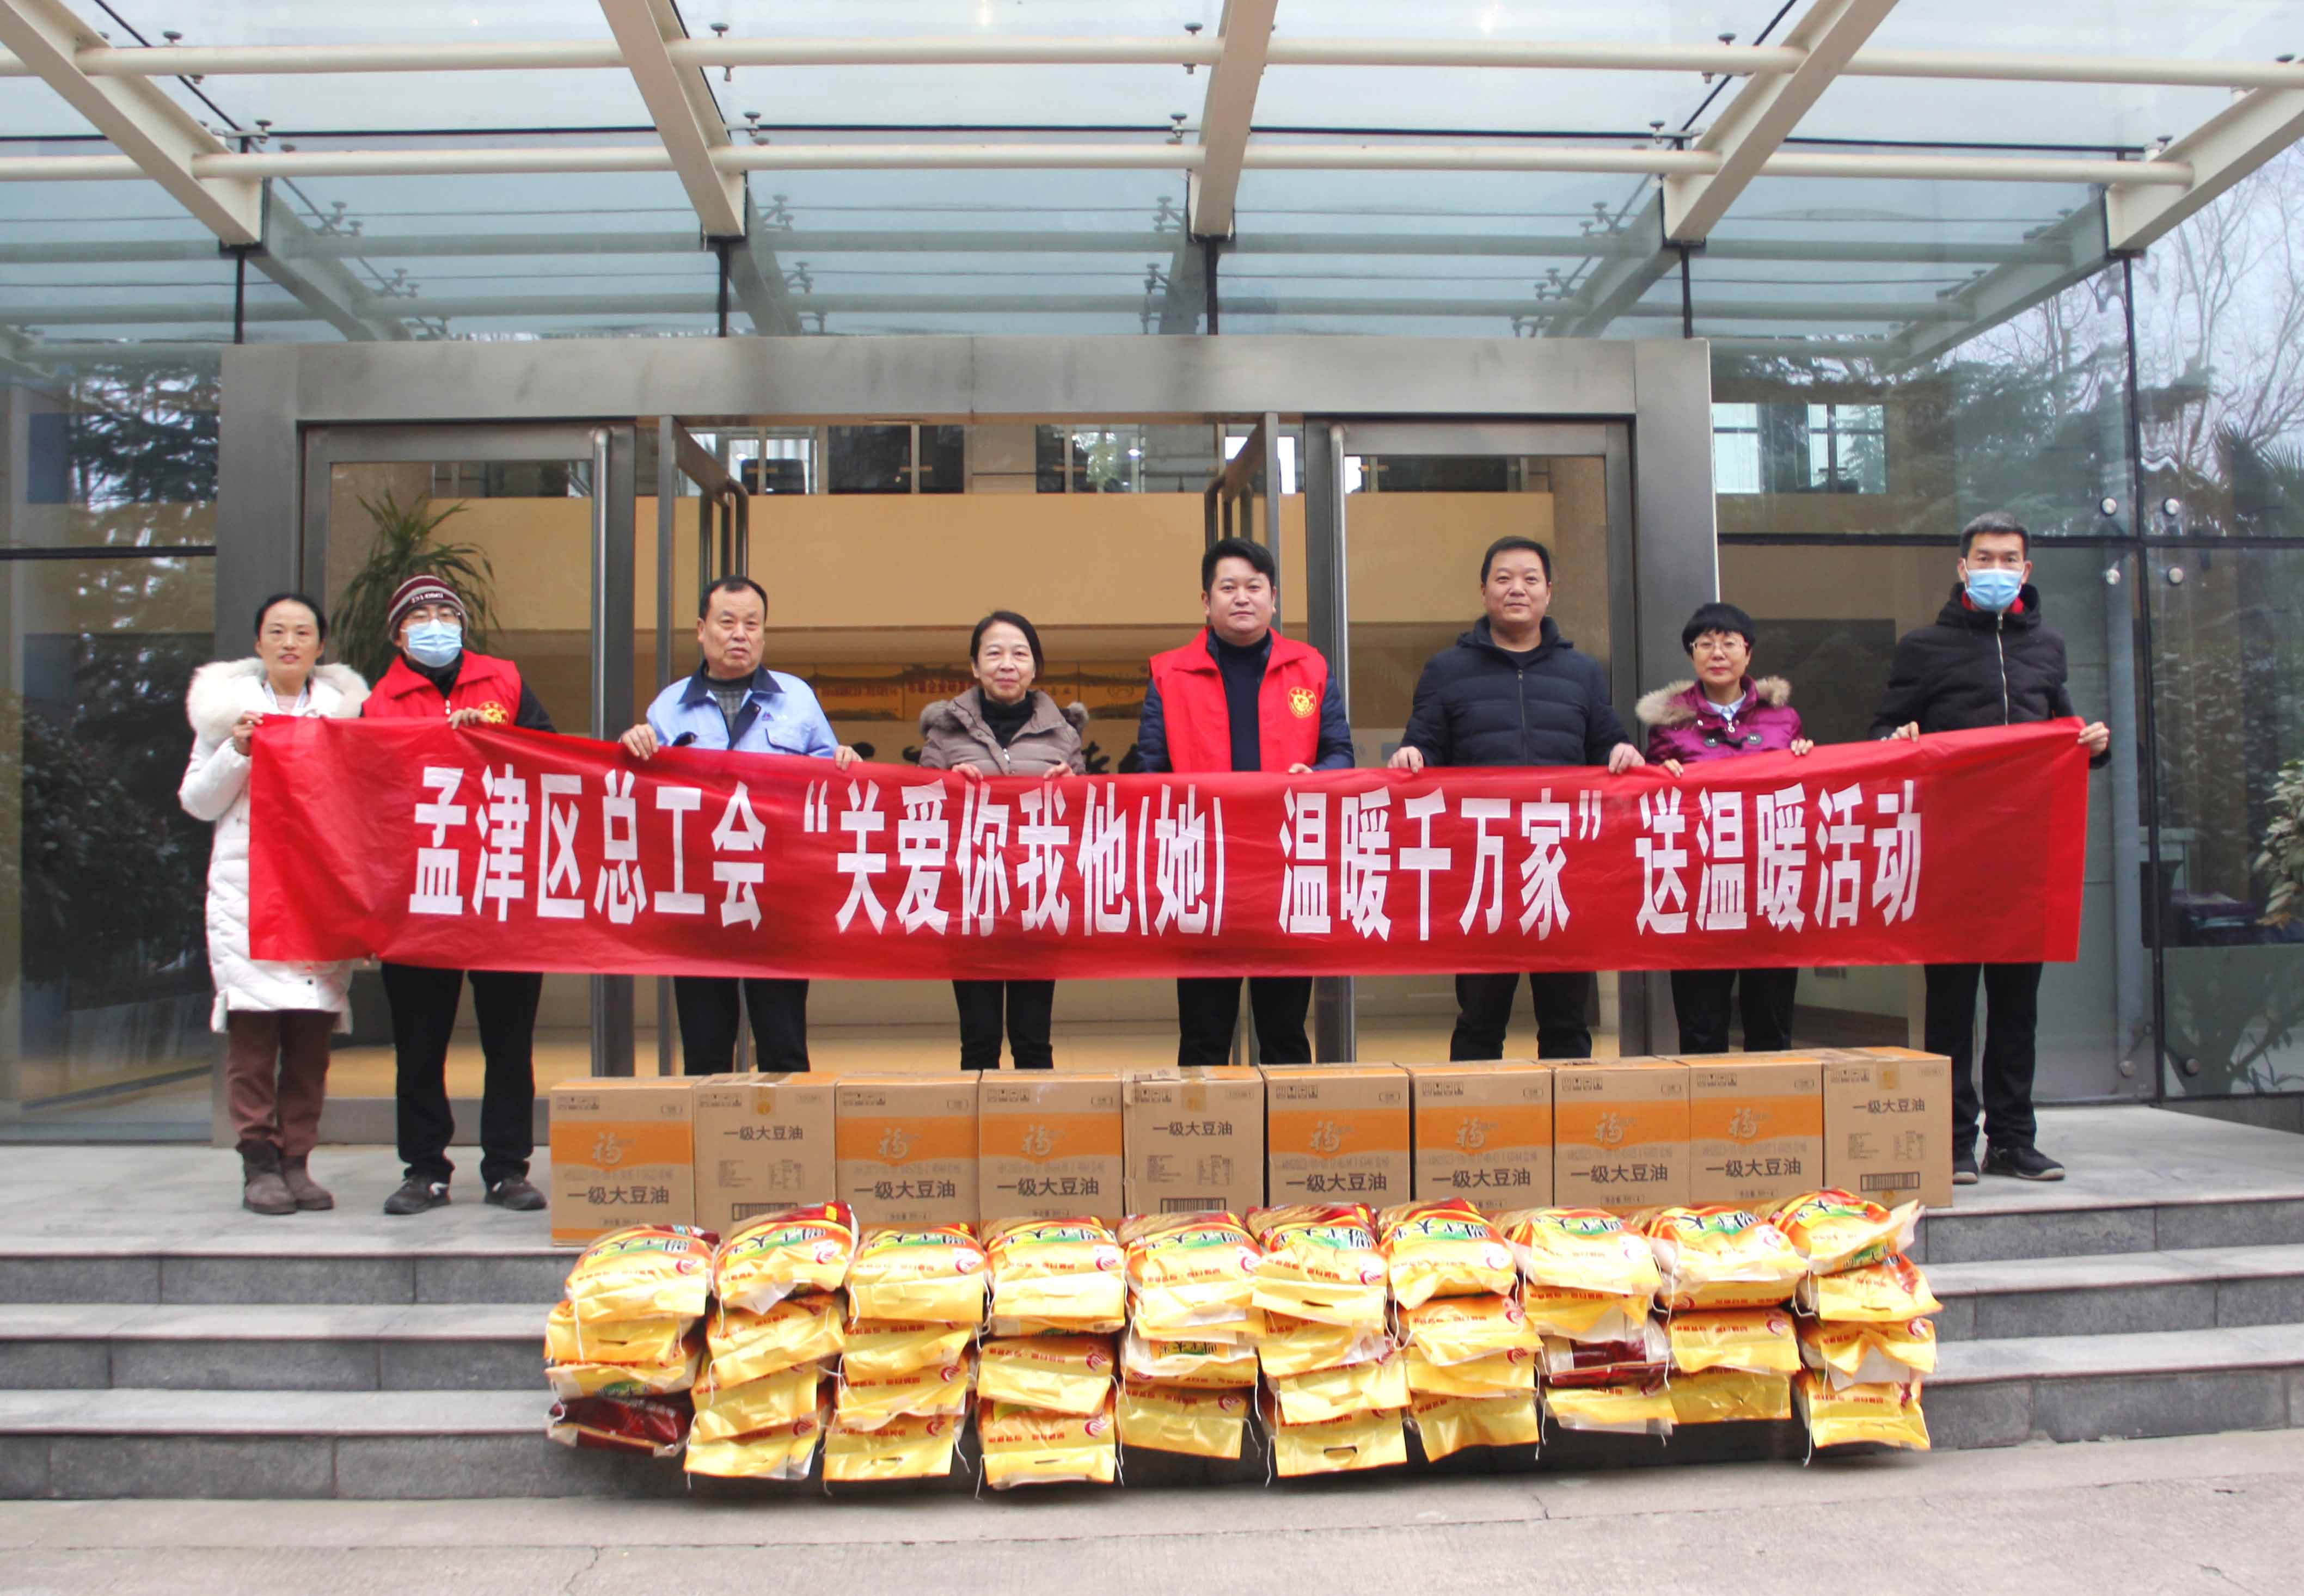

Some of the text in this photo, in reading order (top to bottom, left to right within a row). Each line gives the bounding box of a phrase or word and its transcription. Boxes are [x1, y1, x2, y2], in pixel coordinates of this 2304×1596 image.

[409, 764, 766, 931] 孟津区总工会
[1278, 786, 1602, 941] 温暖千万家”
[1635, 779, 1922, 935] 送温暖活动
[1853, 1098, 1925, 1114] 一级大豆油
[724, 1126, 803, 1140] 一级大豆油
[1153, 1121, 1233, 1136] 一级大豆油
[1571, 1163, 1668, 1183] 一级大豆油
[1706, 1157, 1801, 1178] 一级大豆油
[997, 1177, 1099, 1196] 一级大豆油
[1286, 1172, 1387, 1193] 一级大豆油
[1432, 1168, 1531, 1188] 一级大豆油
[568, 1186, 669, 1205] 一级大豆油
[855, 1180, 955, 1200] 一级大豆油
